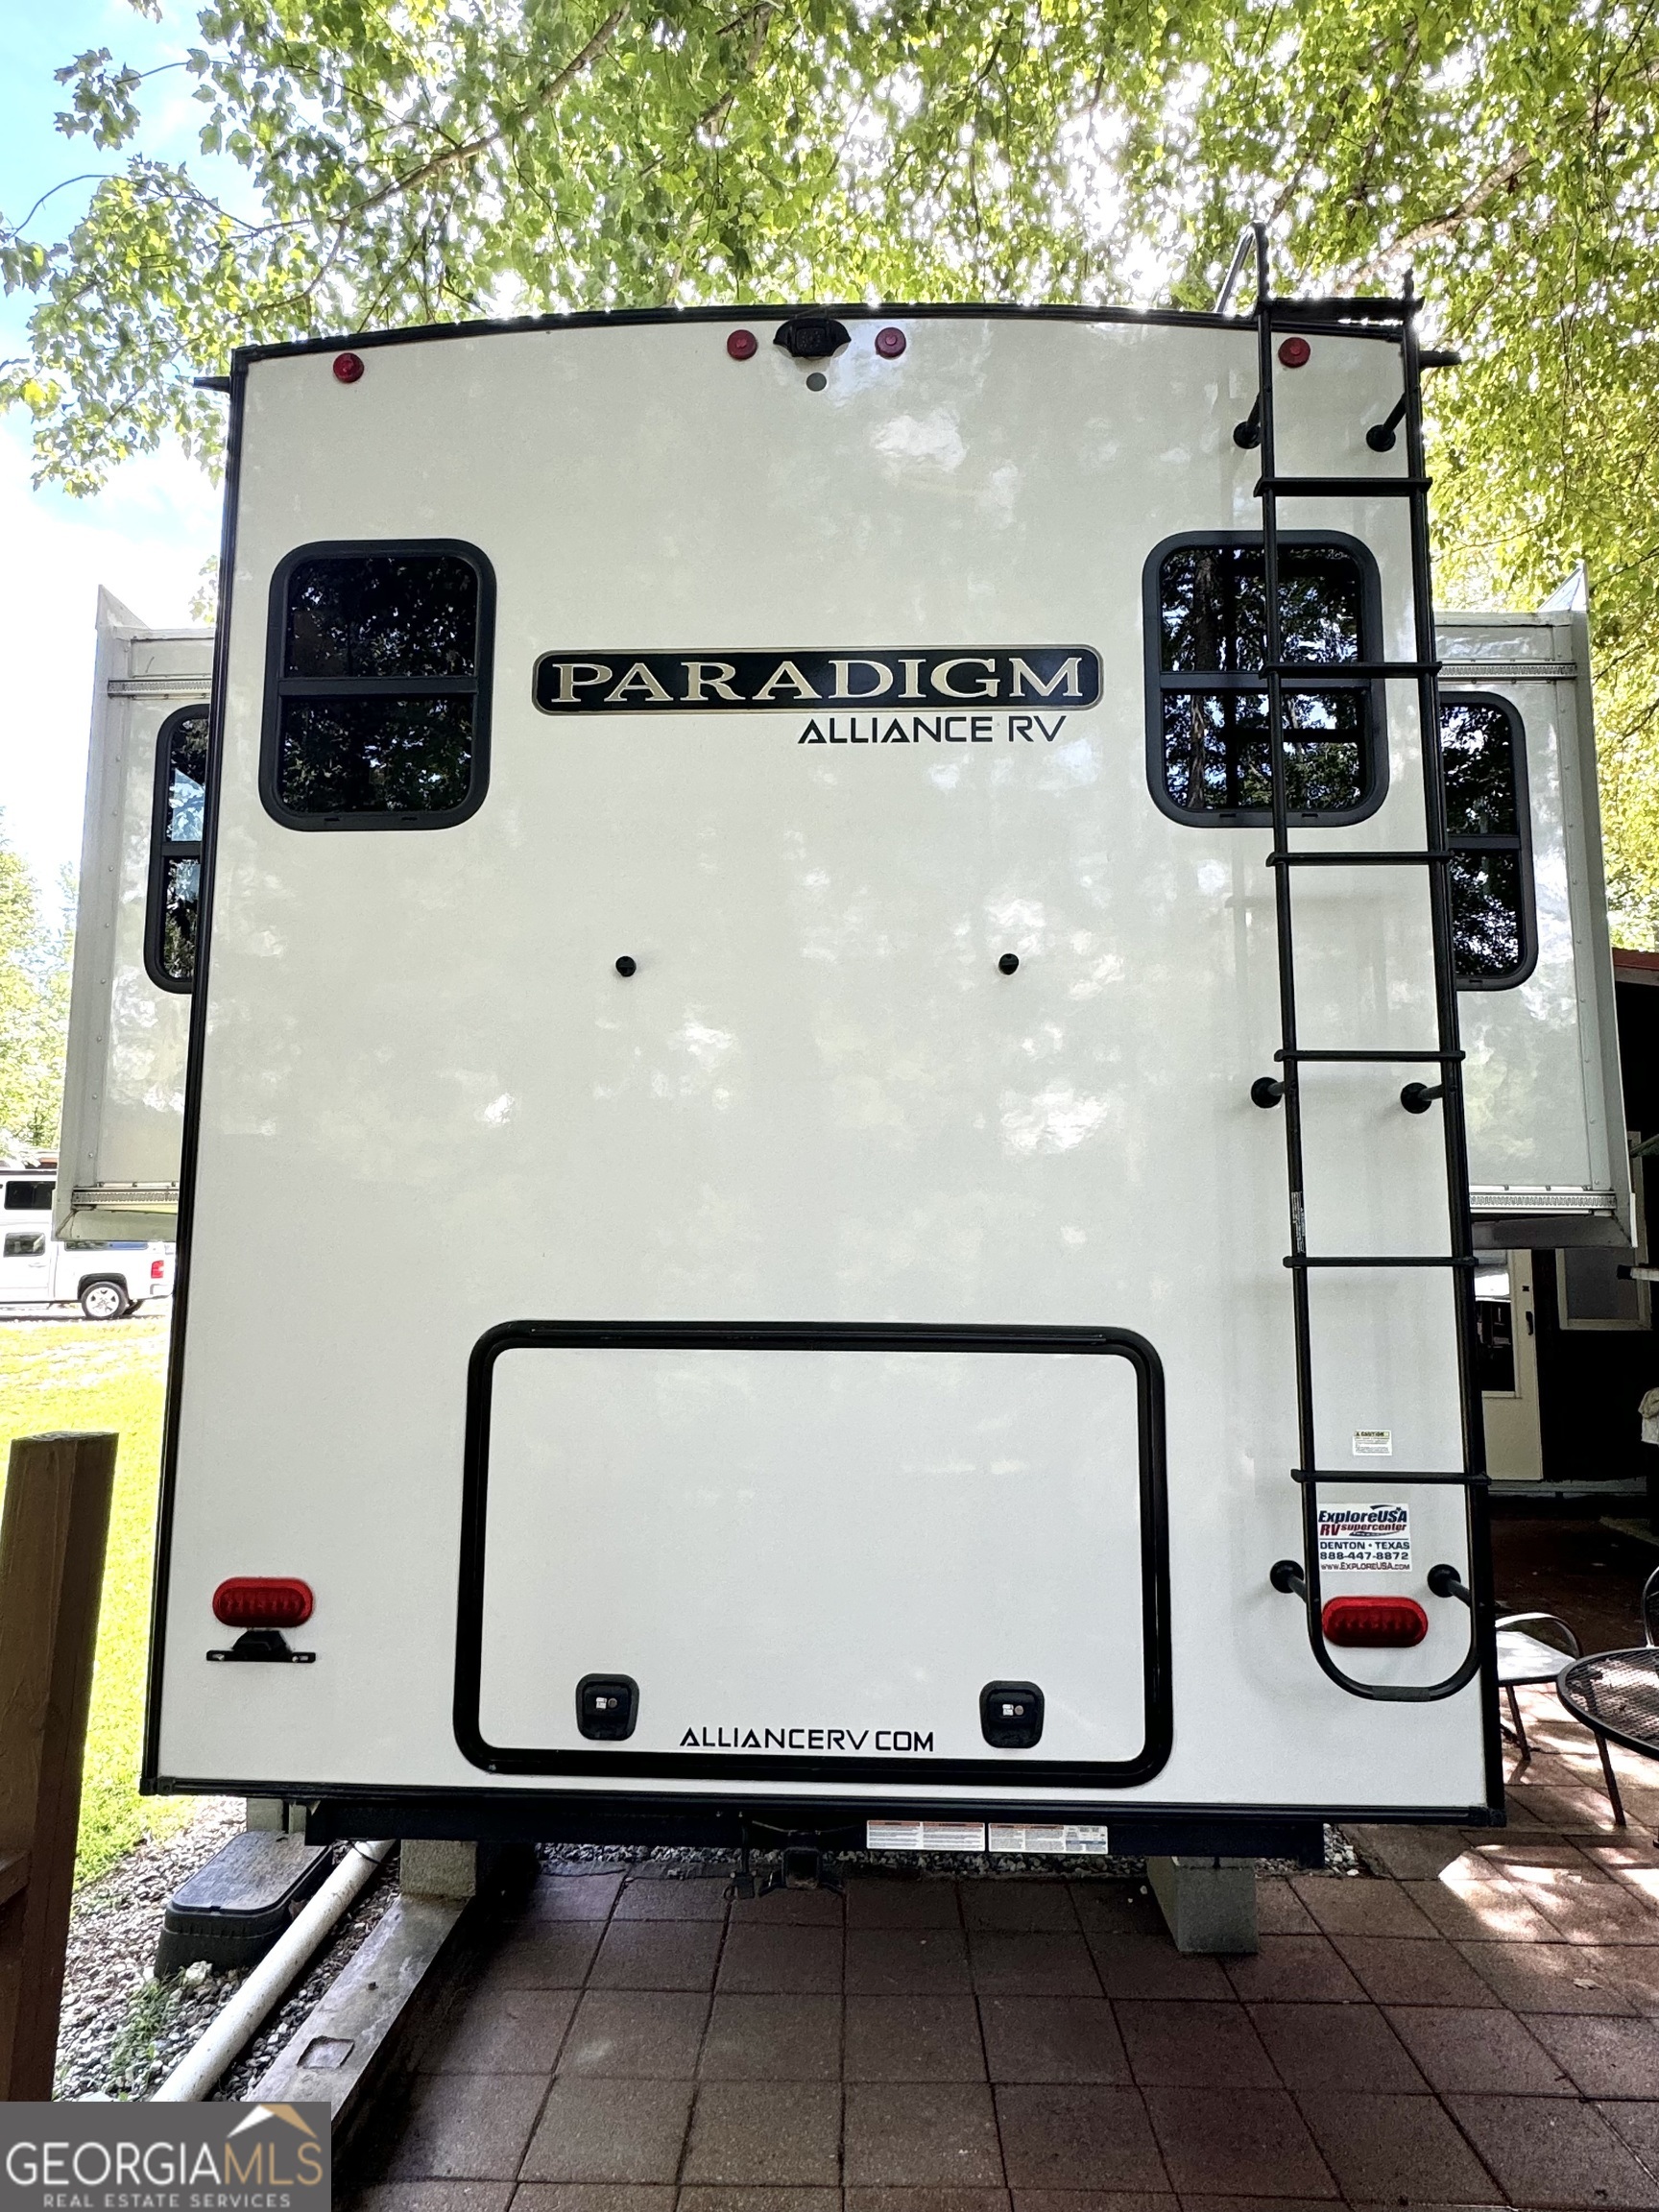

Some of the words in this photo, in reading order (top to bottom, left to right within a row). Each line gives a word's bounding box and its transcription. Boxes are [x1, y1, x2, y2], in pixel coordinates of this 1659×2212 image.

[551, 657, 1083, 703] PARADIGM
[797, 716, 993, 745] ALLIANCE
[1008, 715, 1067, 742] RV
[1318, 1510, 1407, 1524] ExploreUSA
[1320, 1524, 1341, 1536] RV
[1340, 1523, 1407, 1533] supercenter
[1320, 1551, 1409, 1560] 888-447-8872
